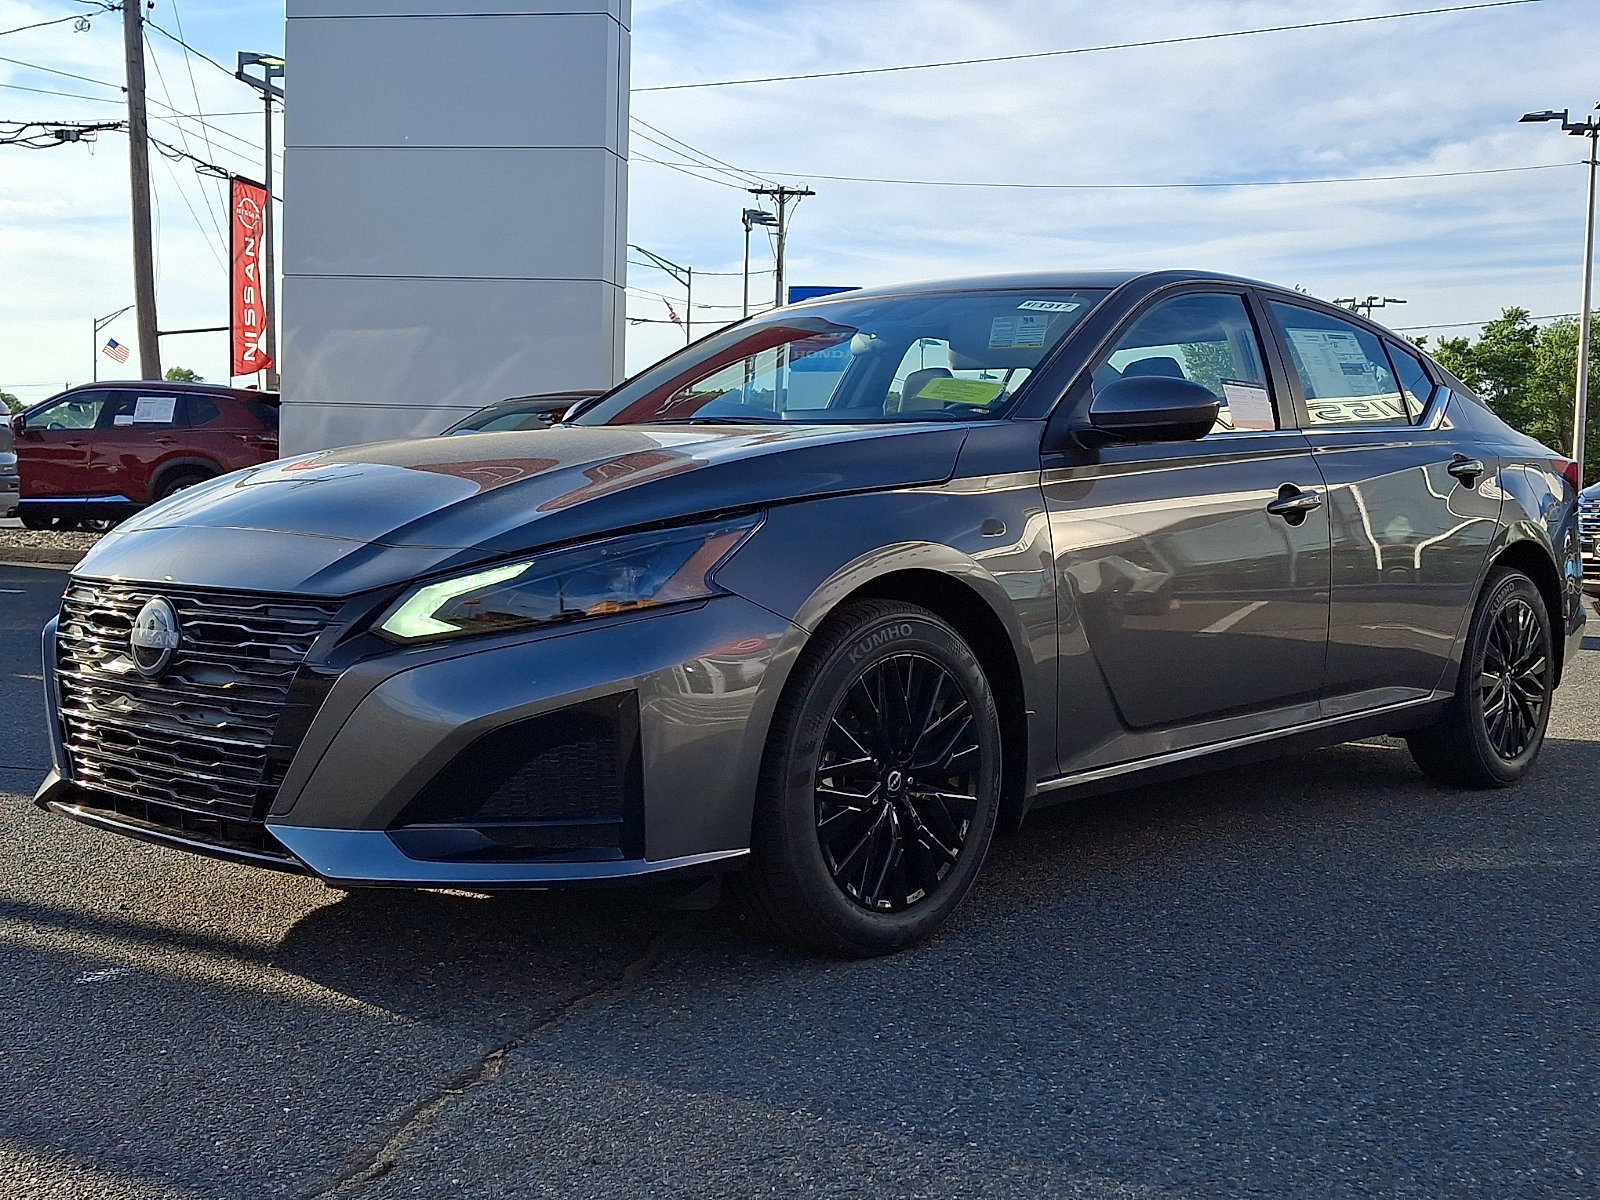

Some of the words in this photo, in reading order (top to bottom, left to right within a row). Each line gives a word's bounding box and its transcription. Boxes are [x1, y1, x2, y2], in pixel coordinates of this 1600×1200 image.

[243, 236, 256, 361] NISSAN
[792, 350, 853, 359] HONDA
[848, 623, 913, 665] KUMHO
